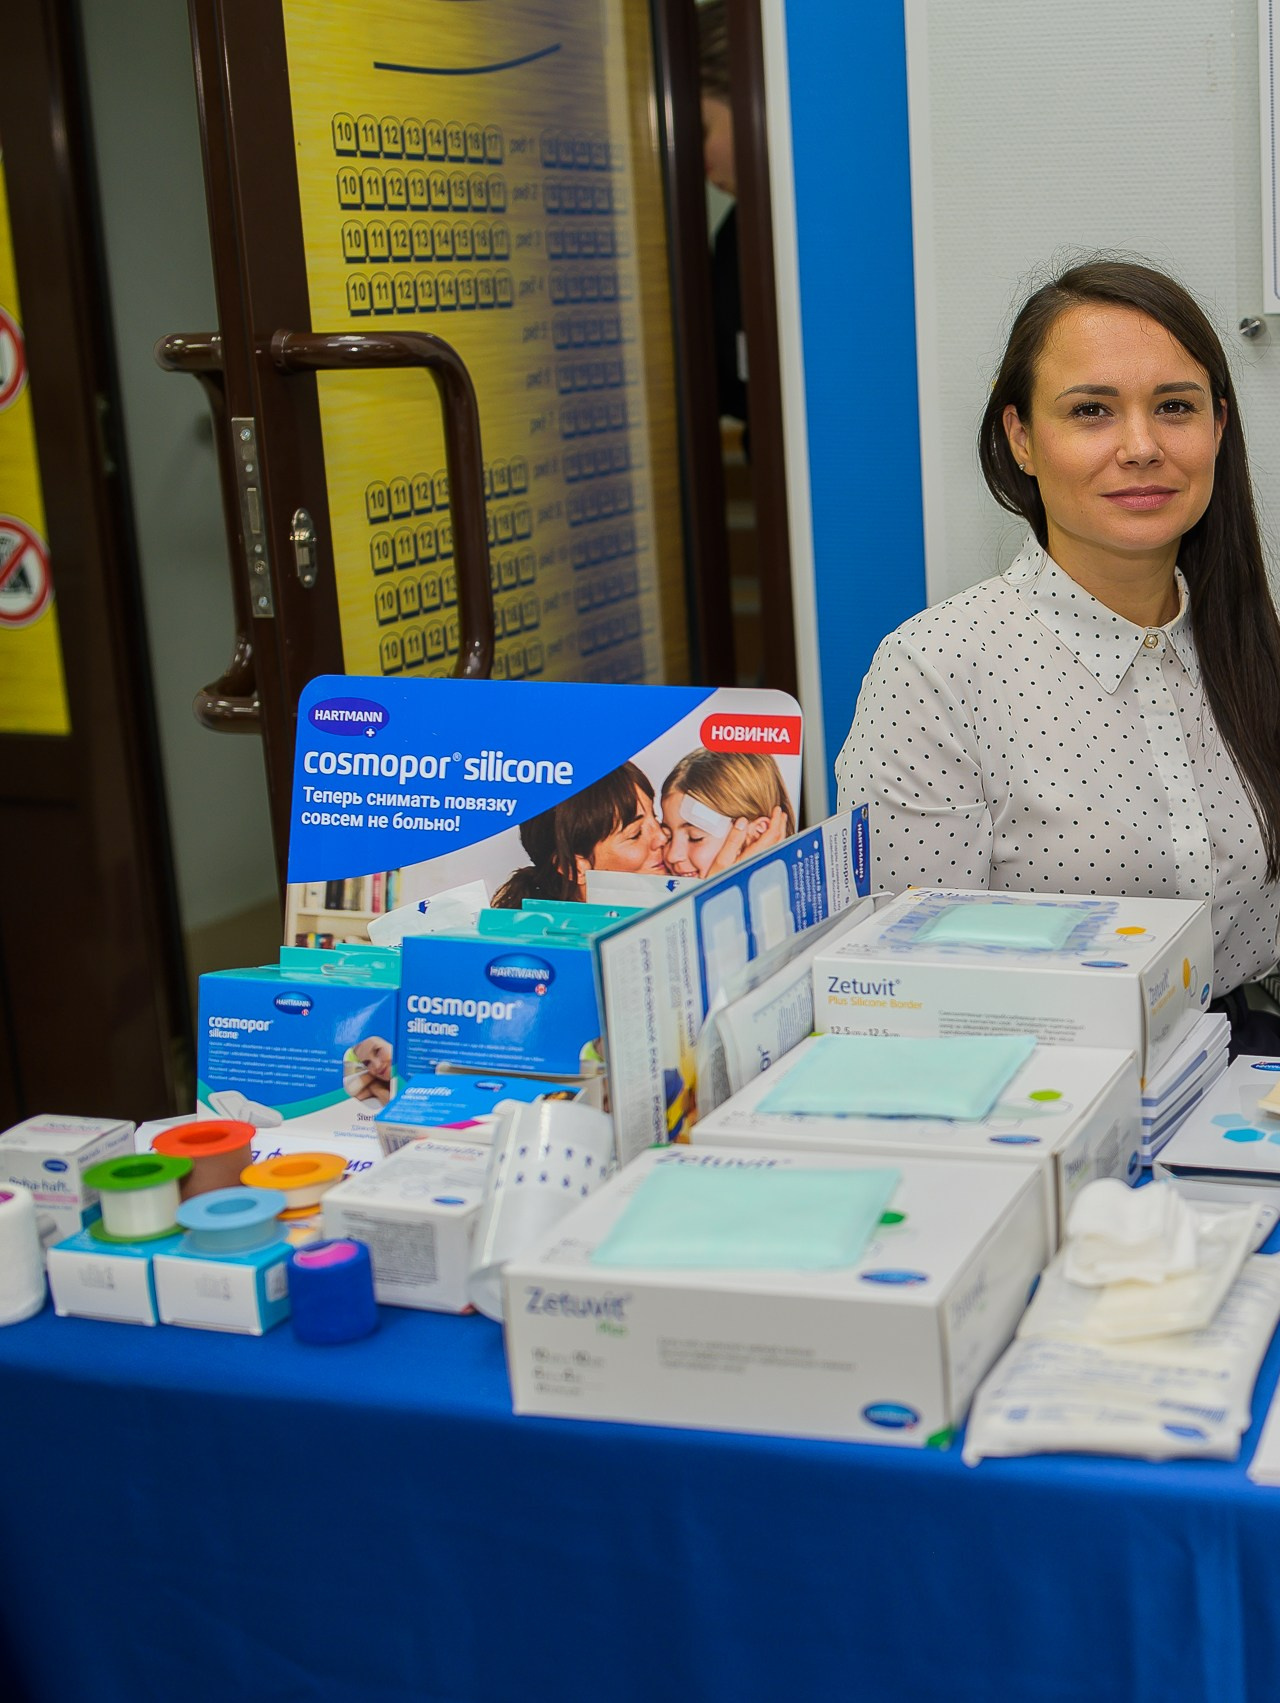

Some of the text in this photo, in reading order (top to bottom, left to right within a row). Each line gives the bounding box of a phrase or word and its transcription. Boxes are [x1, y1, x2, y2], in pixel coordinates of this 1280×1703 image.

[337, 121, 352, 142] 10
[362, 123, 375, 143] 11
[384, 124, 399, 144] 12
[406, 125, 420, 146] 13
[428, 127, 442, 147] 14
[342, 175, 357, 195] 10
[367, 175, 380, 195] 11
[389, 176, 403, 196] 12
[411, 177, 424, 197] 13
[432, 178, 446, 197] 14
[347, 229, 361, 248] 10
[372, 229, 384, 248] 11
[393, 229, 407, 248] 12
[415, 229, 428, 248] 13
[436, 229, 449, 247] 14
[352, 282, 366, 301] 10
[376, 281, 388, 300] 11
[398, 281, 411, 299] 12
[419, 280, 432, 298] 13
[440, 279, 453, 297] 14
[371, 489, 384, 509] 10
[394, 486, 406, 504] 11
[415, 481, 428, 501] 12
[375, 540, 389, 560] 10
[399, 536, 411, 554] 11
[419, 532, 432, 550] 12
[380, 590, 393, 610] 10
[403, 586, 415, 604] 11
[424, 583, 437, 599] 12
[384, 641, 398, 660] 10
[407, 636, 419, 653] 11
[429, 629, 441, 648] 12
[314, 709, 383, 723] HARTMANN
[711, 725, 791, 743] НОВИНКА
[463, 750, 574, 785] silicone
[303, 786, 517, 816] Теперь снимать повязку
[301, 811, 460, 832] совсем не больно!
[828, 995, 848, 1005] Plus
[889, 998, 923, 1009] Border
[208, 1028, 239, 1040] silicone
[407, 1017, 460, 1037] silicone
